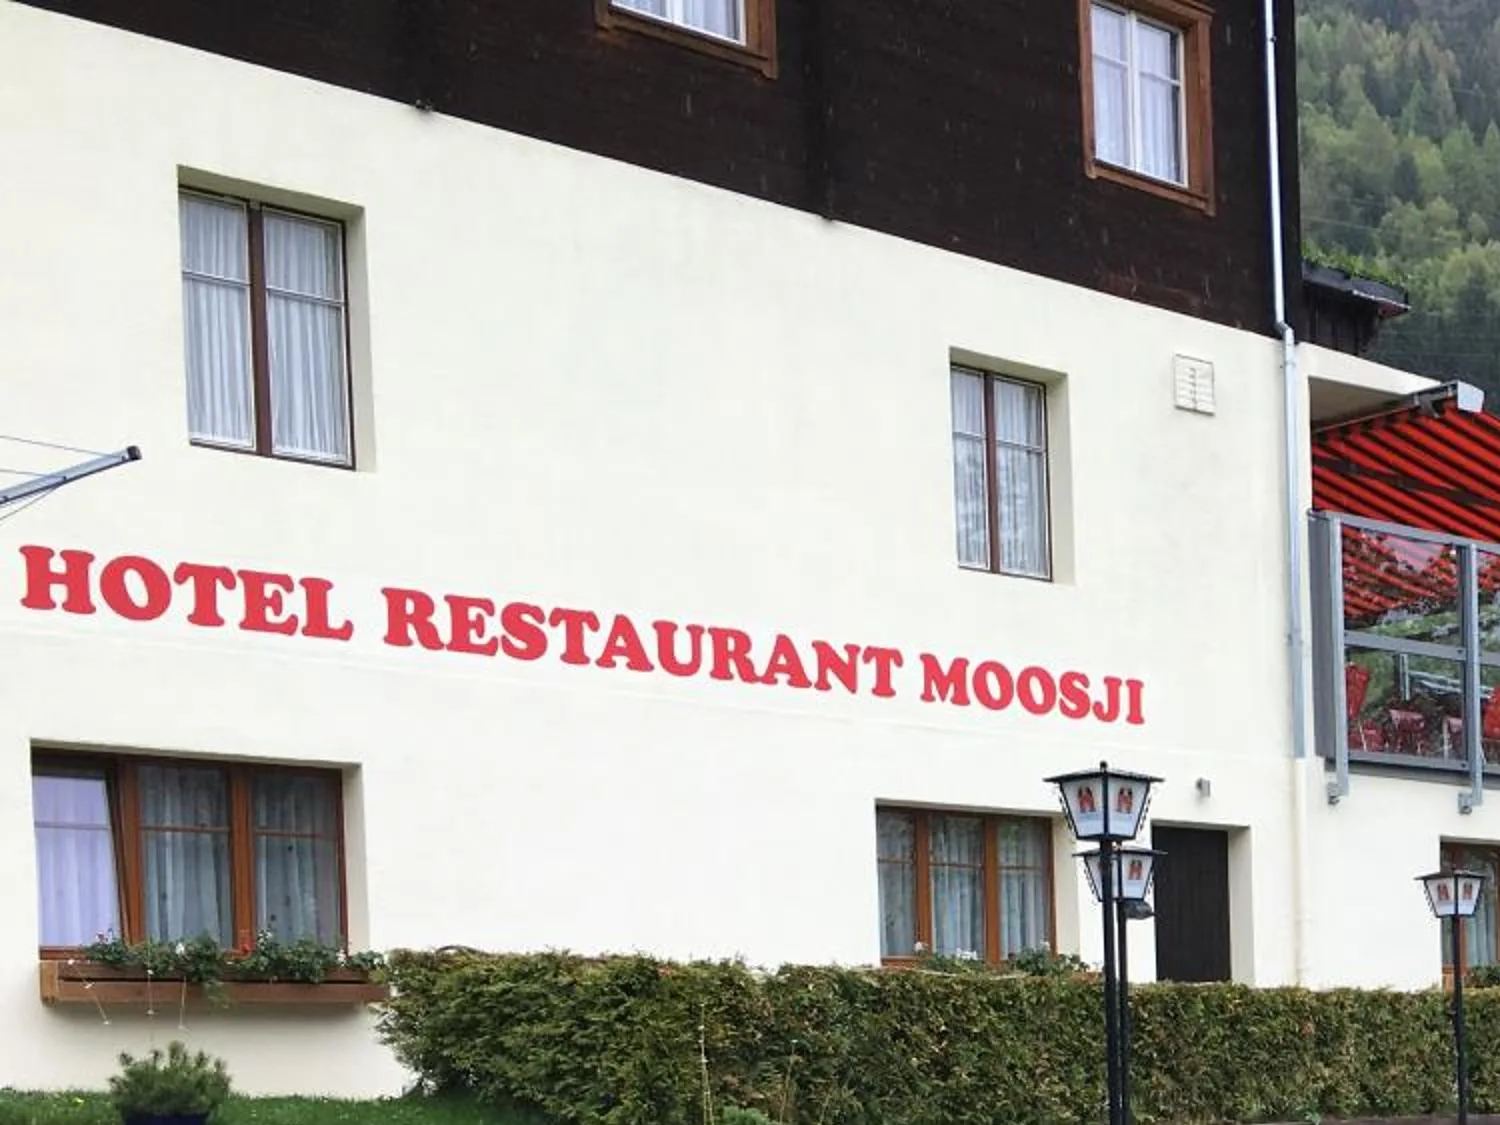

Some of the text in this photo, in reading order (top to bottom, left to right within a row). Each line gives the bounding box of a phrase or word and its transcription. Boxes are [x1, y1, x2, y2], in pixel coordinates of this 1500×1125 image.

[22, 545, 1143, 726] HOTEL RESTAURANT MOOSJI
